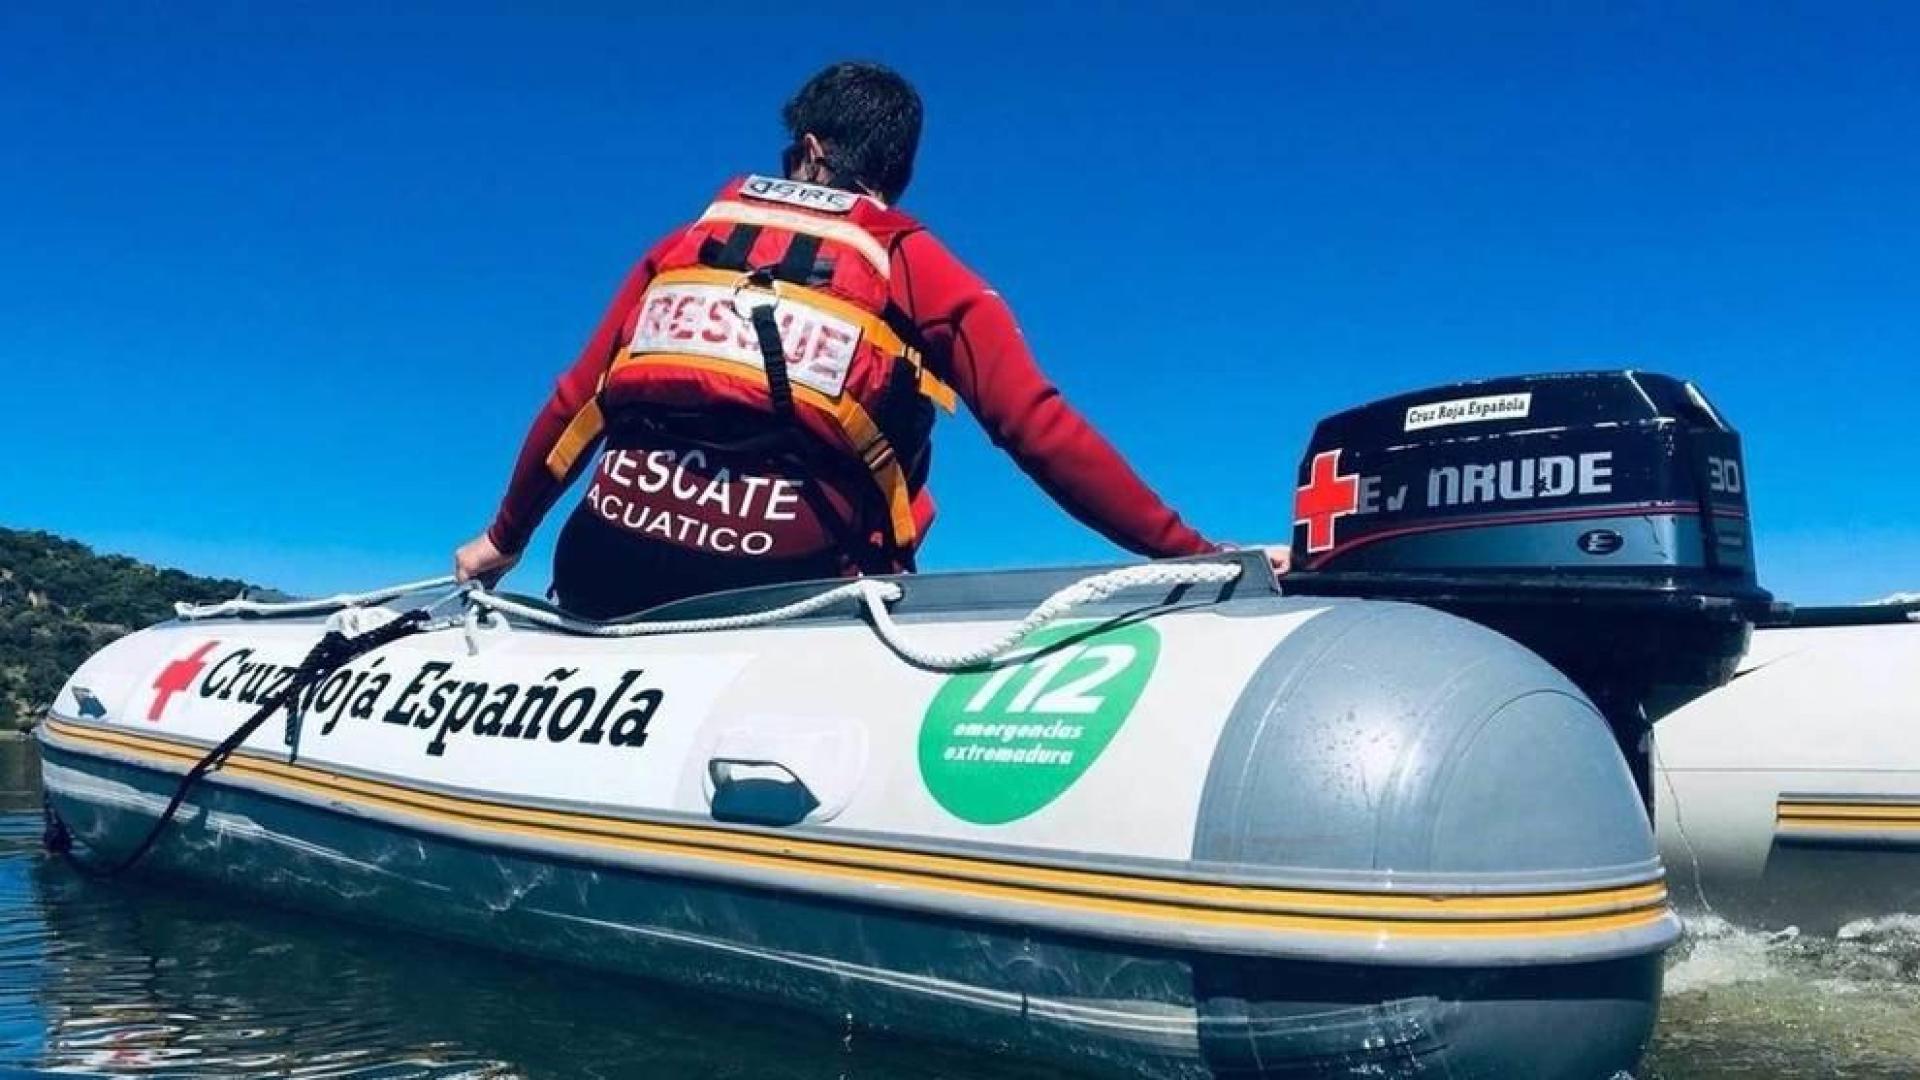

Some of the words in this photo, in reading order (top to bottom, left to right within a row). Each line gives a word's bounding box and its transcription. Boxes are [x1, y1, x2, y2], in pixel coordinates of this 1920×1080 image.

[1359, 451, 1613, 514] ENRUDE
[1708, 456, 1741, 494] 30
[587, 483, 774, 556] ACUATICO
[200, 647, 300, 705] Cruz
[383, 660, 665, 757] Española
[963, 644, 1138, 715] 112
[943, 743, 1075, 765] extremadura
[952, 719, 1084, 743] emergencias
